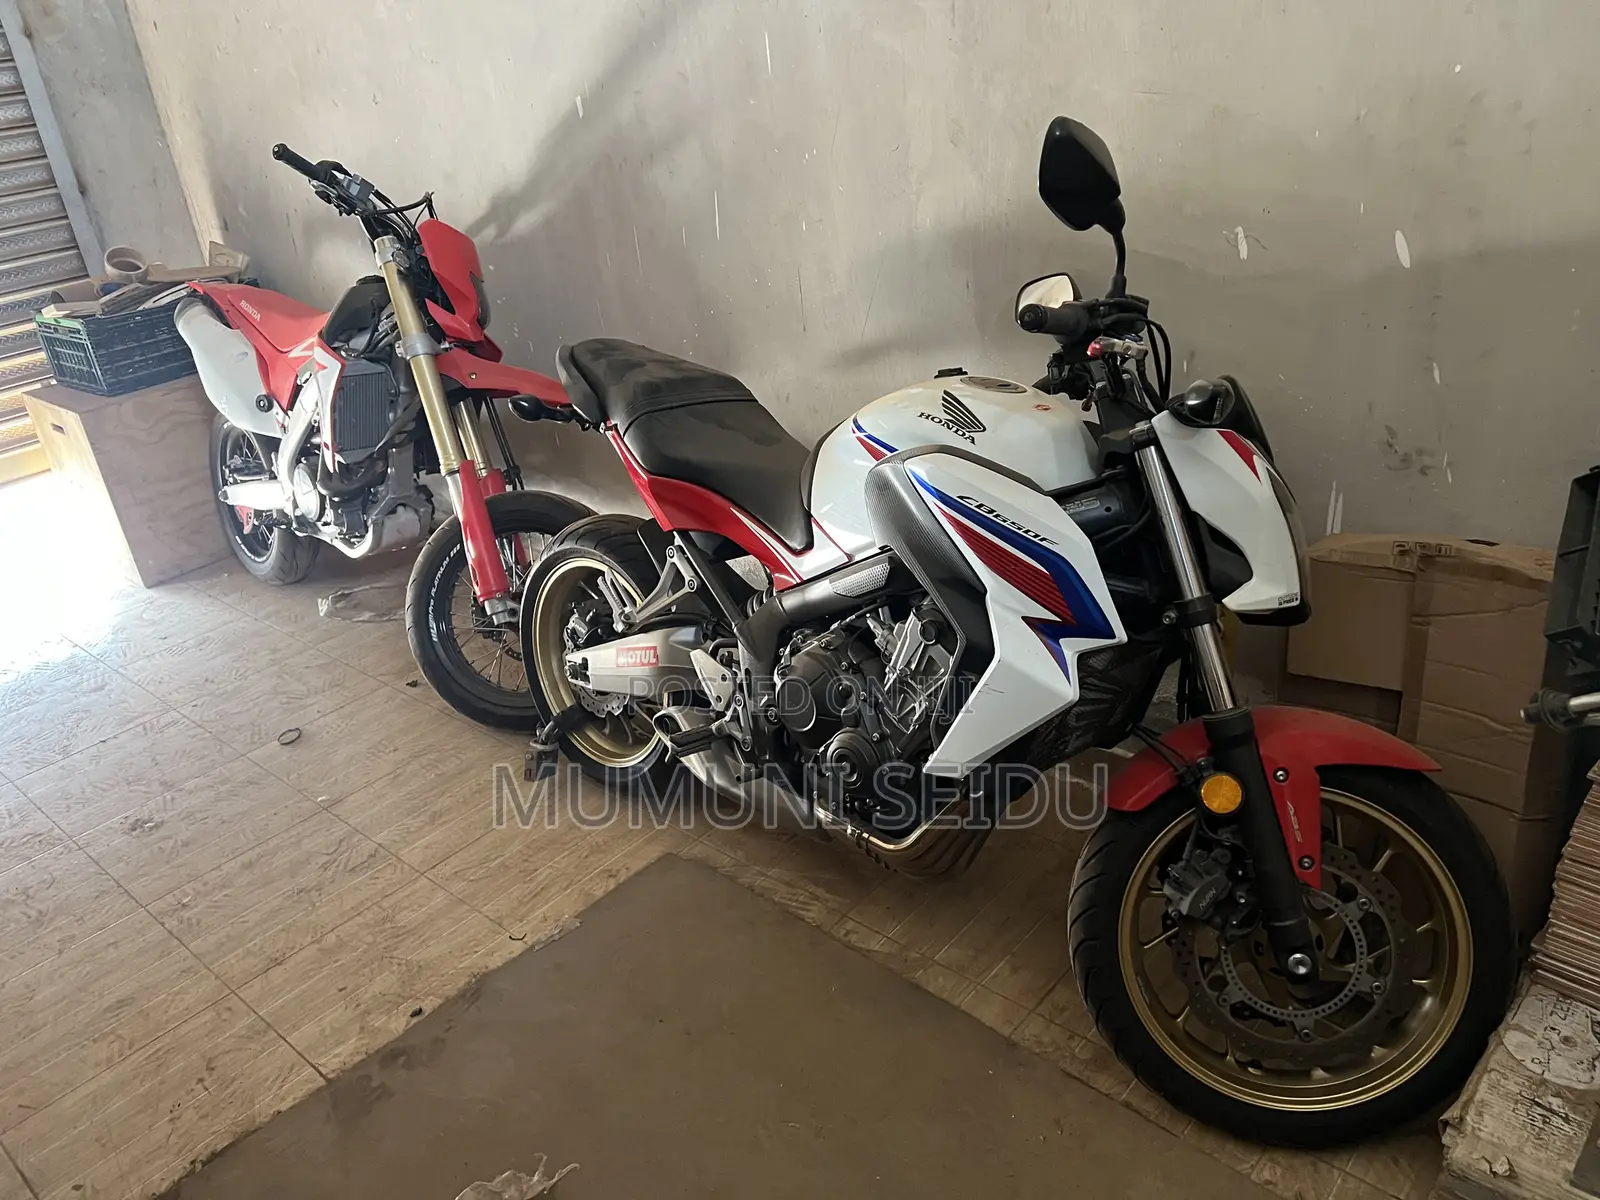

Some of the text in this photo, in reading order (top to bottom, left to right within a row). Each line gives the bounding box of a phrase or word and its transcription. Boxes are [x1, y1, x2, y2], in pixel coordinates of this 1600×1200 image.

[239, 299, 261, 322] HONDA
[917, 411, 976, 446] HONDA
[955, 494, 1060, 546] CB650F
[430, 556, 450, 597] PLATINUM
[617, 649, 657, 667] MOTUL
[1286, 800, 1303, 843] ABS
